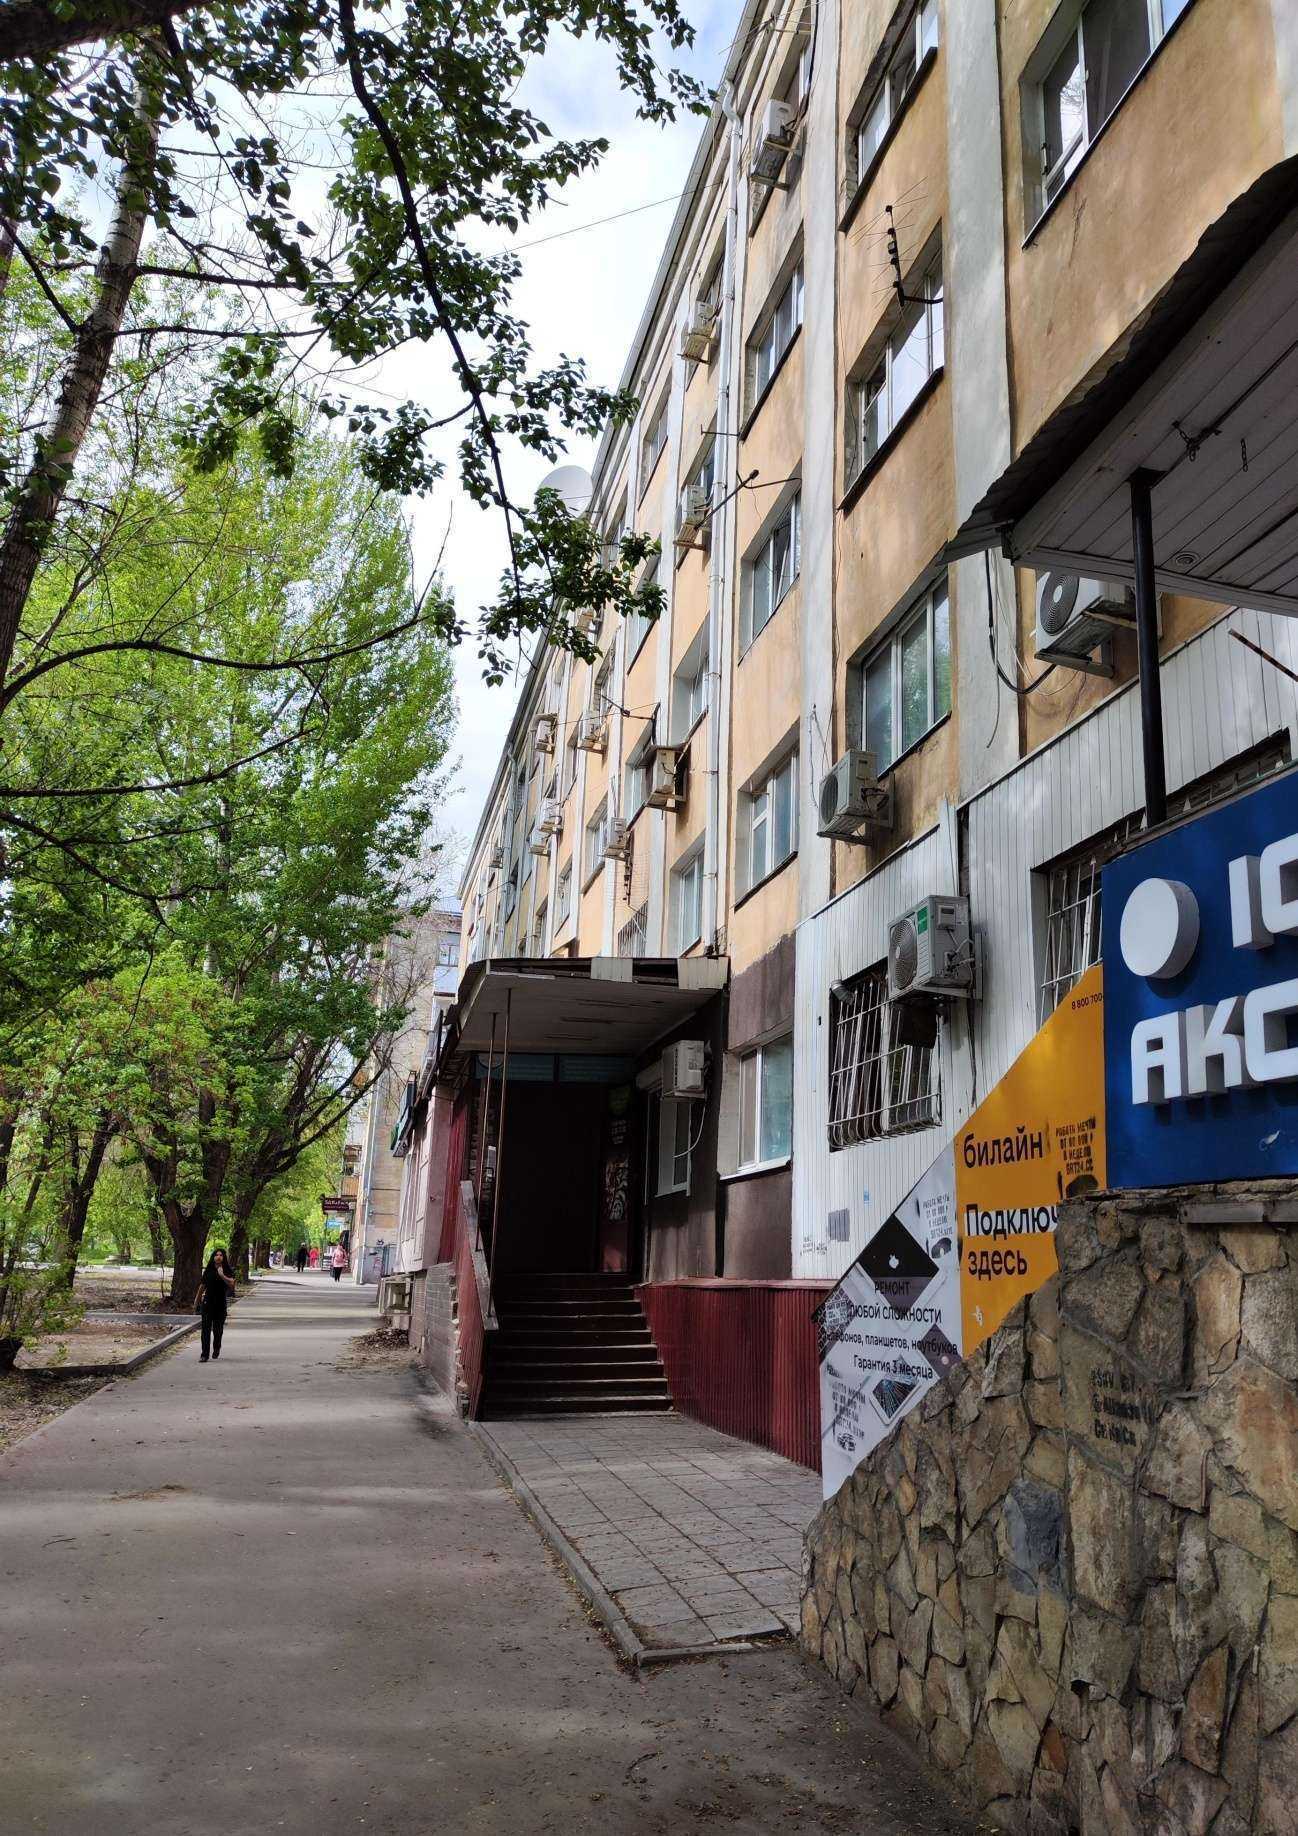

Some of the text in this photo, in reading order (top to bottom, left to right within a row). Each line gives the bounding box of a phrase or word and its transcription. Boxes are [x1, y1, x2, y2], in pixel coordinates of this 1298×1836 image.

[963, 1125, 1043, 1168] билайн
[967, 1249, 1028, 1281] здесь
[874, 1281, 911, 1296] РЕМОНТ
[850, 1303, 881, 1319] ЛЮБОЙ
[882, 1306, 942, 1324] СЛОЖНОСТИ
[865, 1334, 910, 1351] планшетов,
[911, 1339, 958, 1355] ноутбуков
[853, 1355, 891, 1373] Гарантия
[891, 1360, 898, 1374] 3
[899, 1363, 934, 1380] месяца
